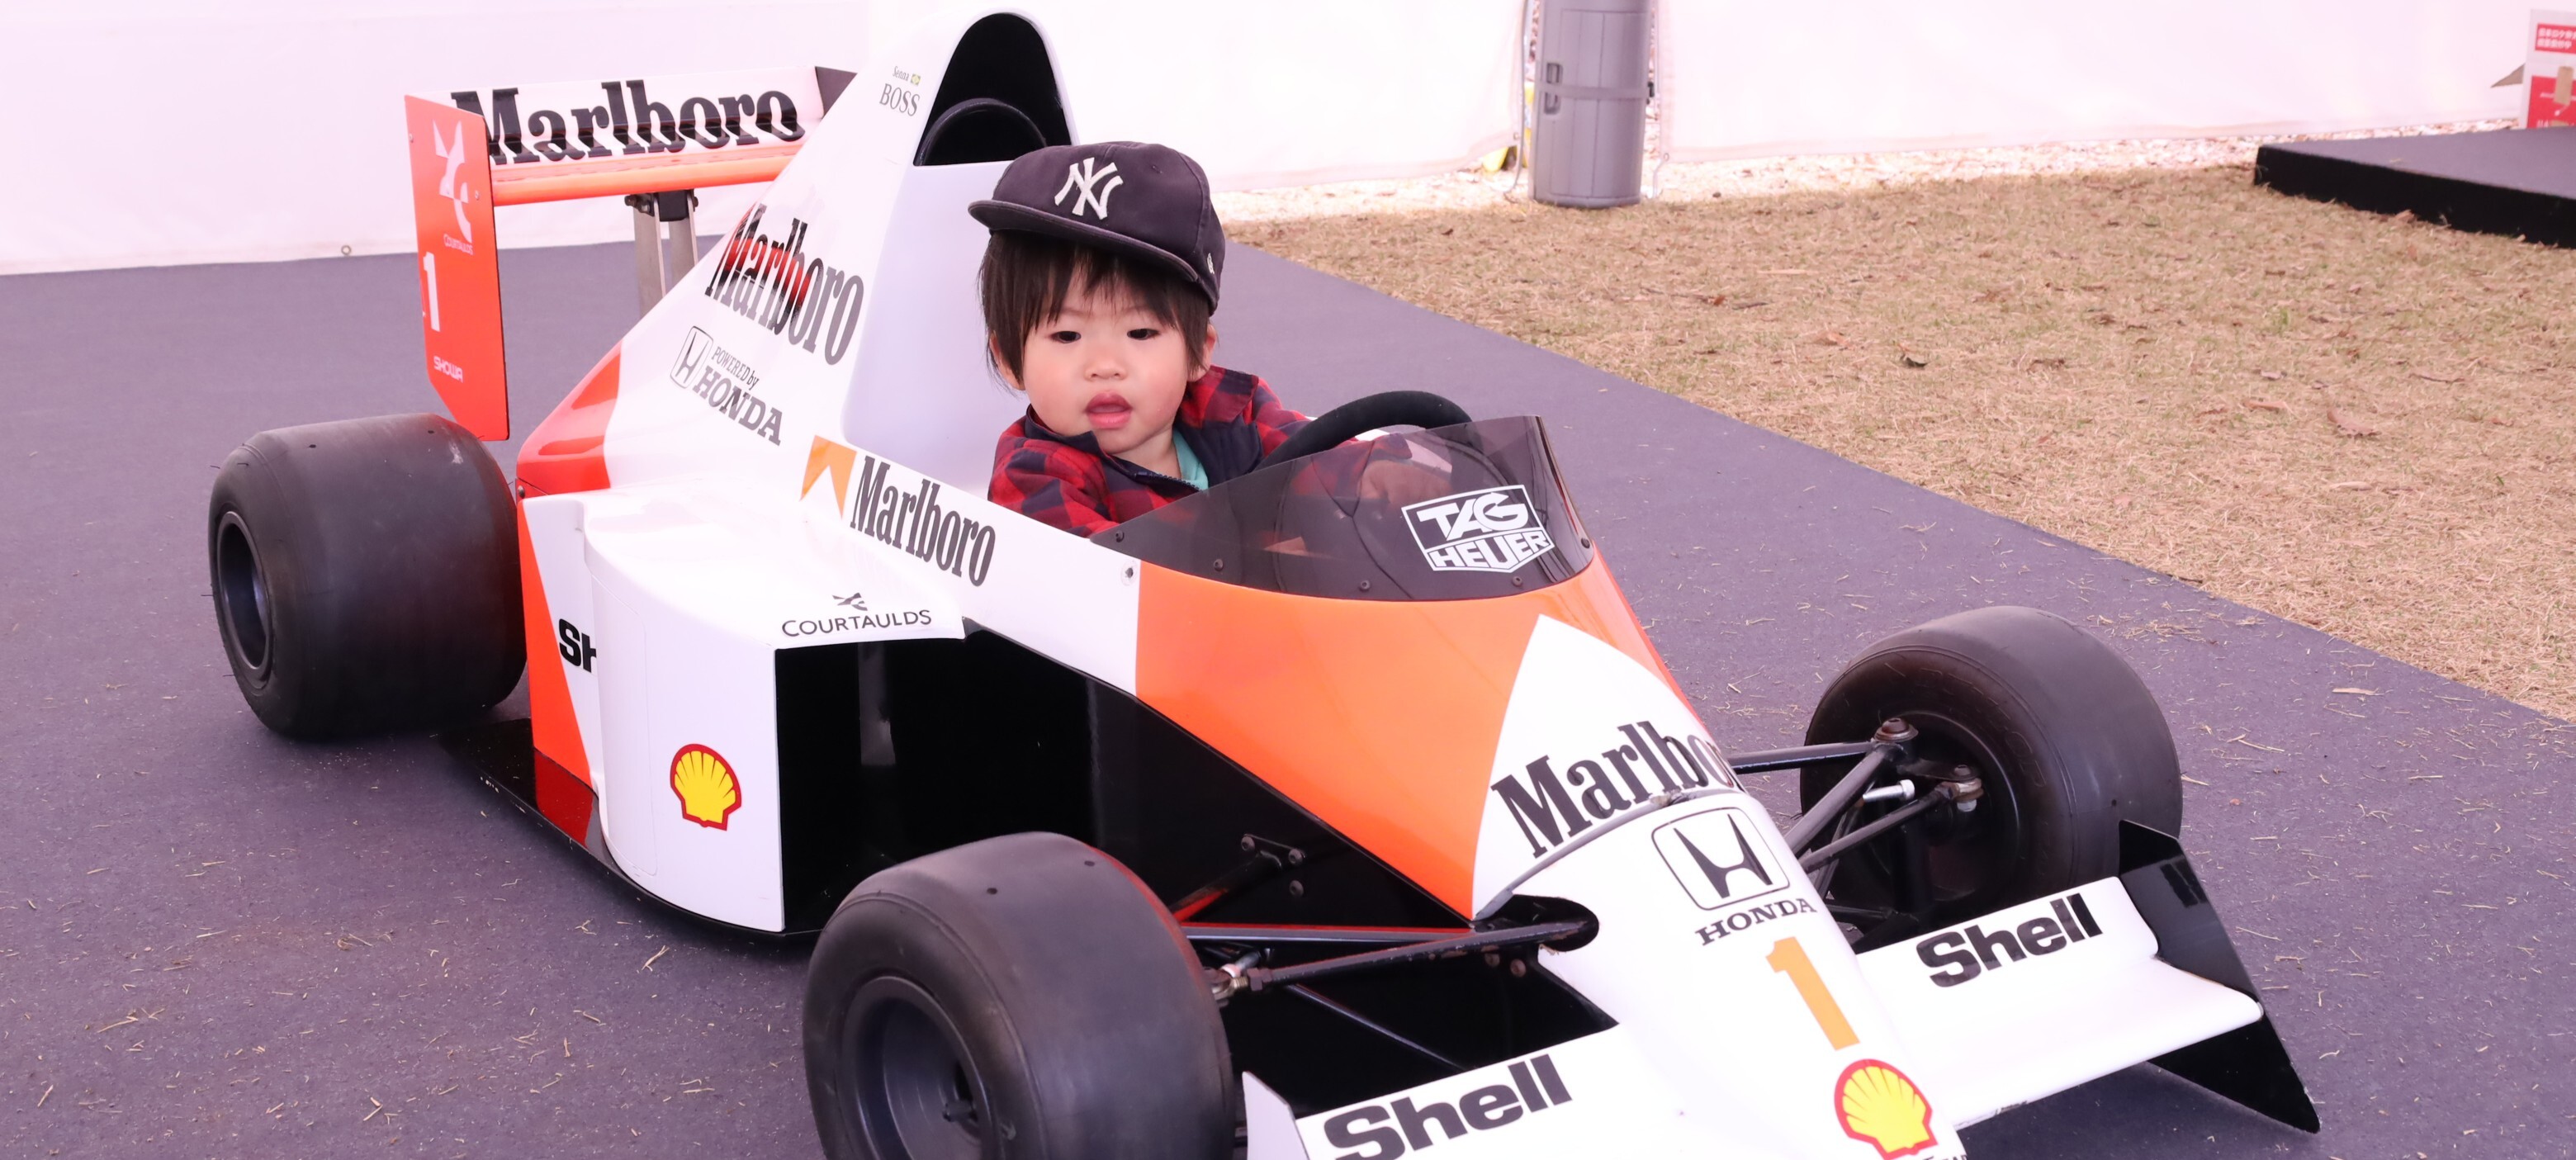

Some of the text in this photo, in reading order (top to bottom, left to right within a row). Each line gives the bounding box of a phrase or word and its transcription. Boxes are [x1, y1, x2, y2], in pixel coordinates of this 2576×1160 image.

[879, 83, 921, 116] BOSS
[892, 65, 910, 82] Senna
[450, 79, 806, 166] Marlboro
[1054, 157, 1124, 220] NY
[423, 251, 440, 332] 1
[704, 203, 864, 366] Marlboro
[433, 355, 463, 383] SHOWA
[711, 346, 760, 391] POWERED by
[692, 365, 783, 446] HONDA
[850, 455, 996, 587] Marlboro
[1416, 492, 1529, 541] TAG
[1428, 529, 1551, 570] HEUER
[782, 609, 932, 637] COURTAULDS
[1490, 720, 1745, 859] Marlbo
[1694, 897, 1818, 945] HONDA
[1915, 892, 2104, 987] Shell
[1765, 935, 1860, 1051] 1
[1324, 1053, 1573, 1160] Shell
